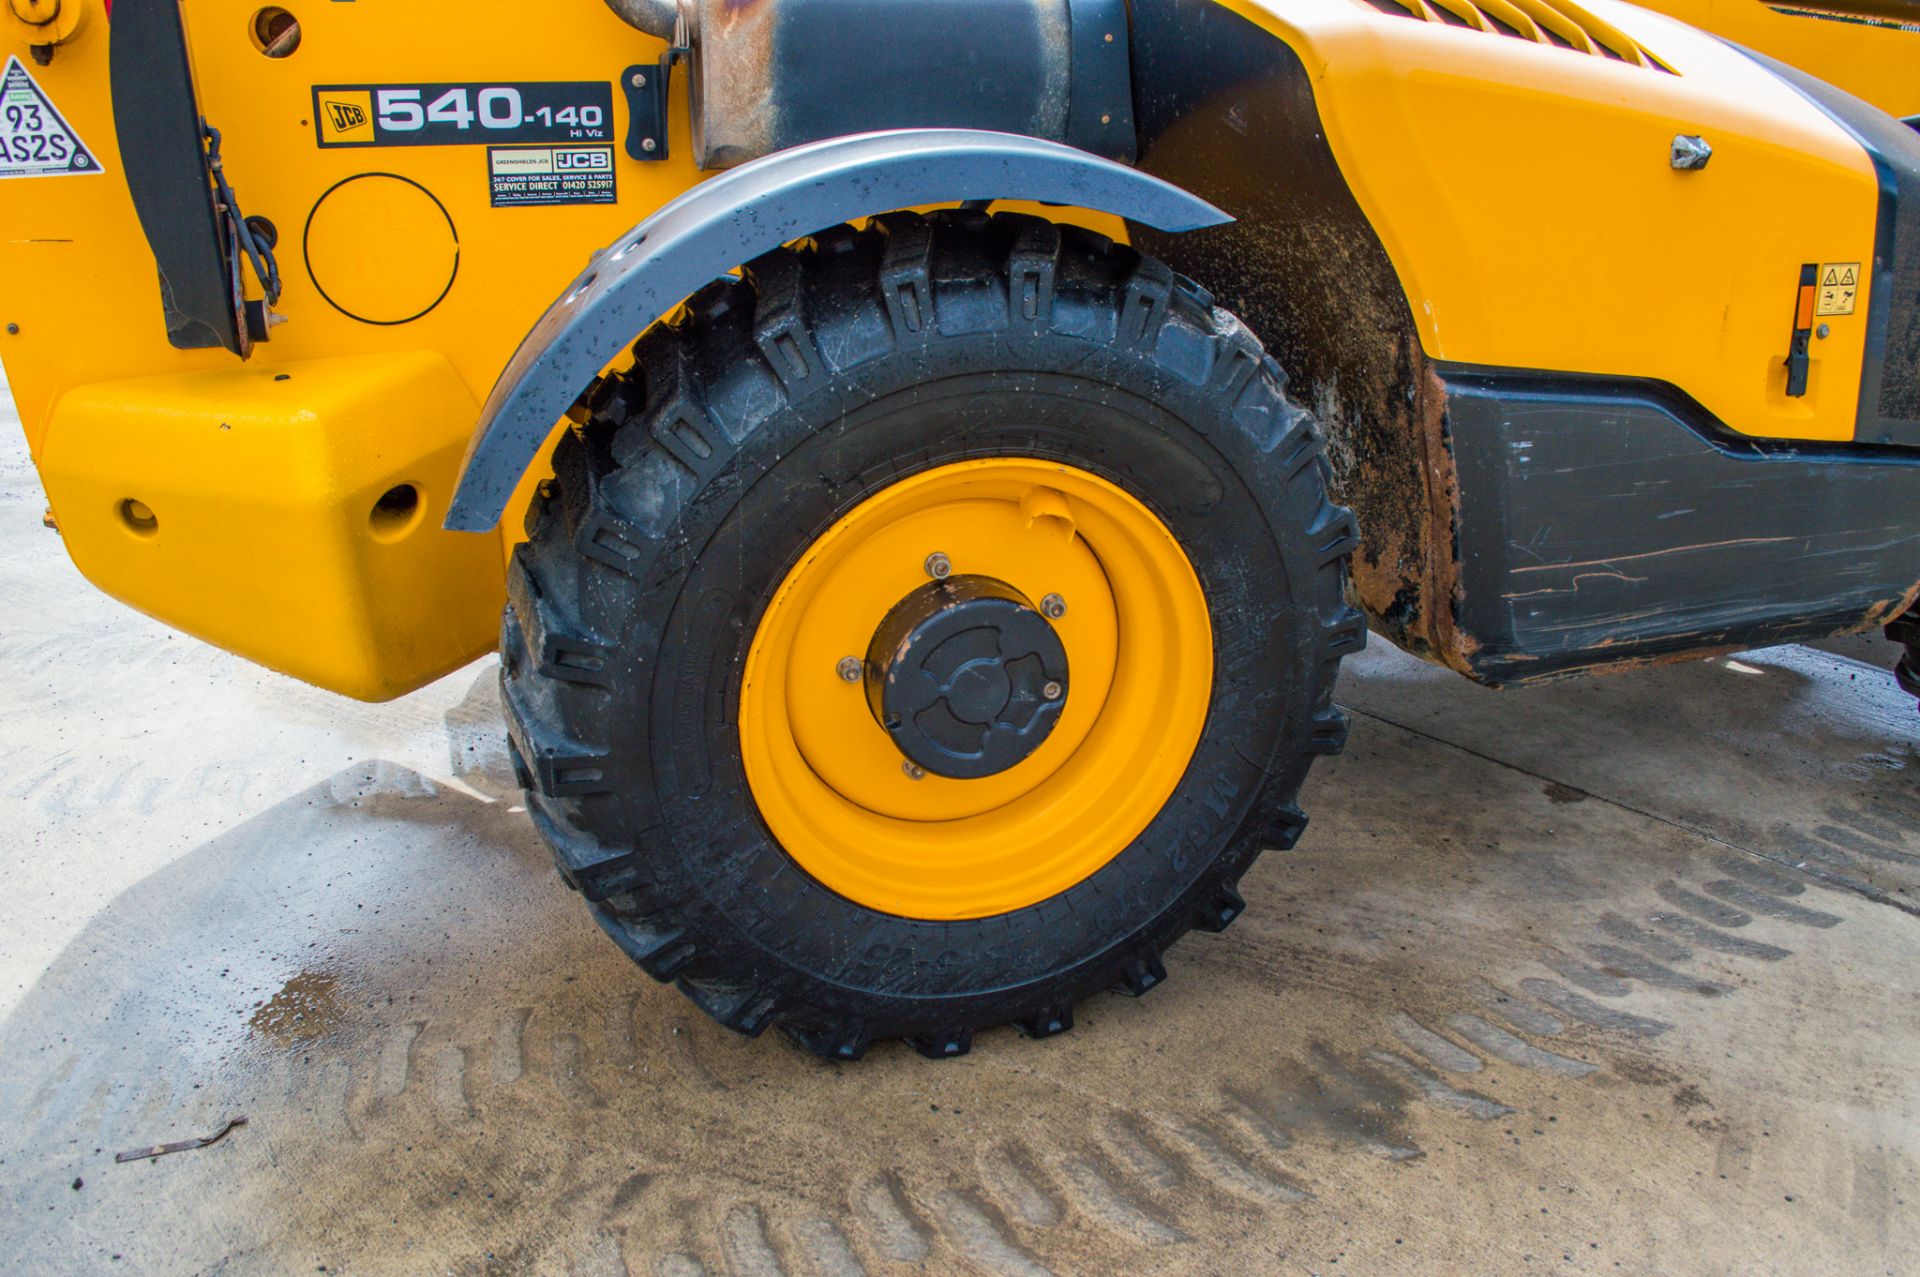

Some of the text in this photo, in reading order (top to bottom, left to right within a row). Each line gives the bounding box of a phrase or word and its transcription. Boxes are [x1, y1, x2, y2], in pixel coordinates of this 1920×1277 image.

[6, 104, 43, 133] 93
[334, 104, 365, 130] JCB
[377, 87, 603, 131] 540-140
[570, 128, 604, 138] Hi Viz
[0, 134, 68, 162] AS2S
[495, 158, 537, 166] GREENSHIELDS
[558, 153, 608, 168] JCB
[494, 180, 613, 192] SERVICE DIRECT 01420 525917
